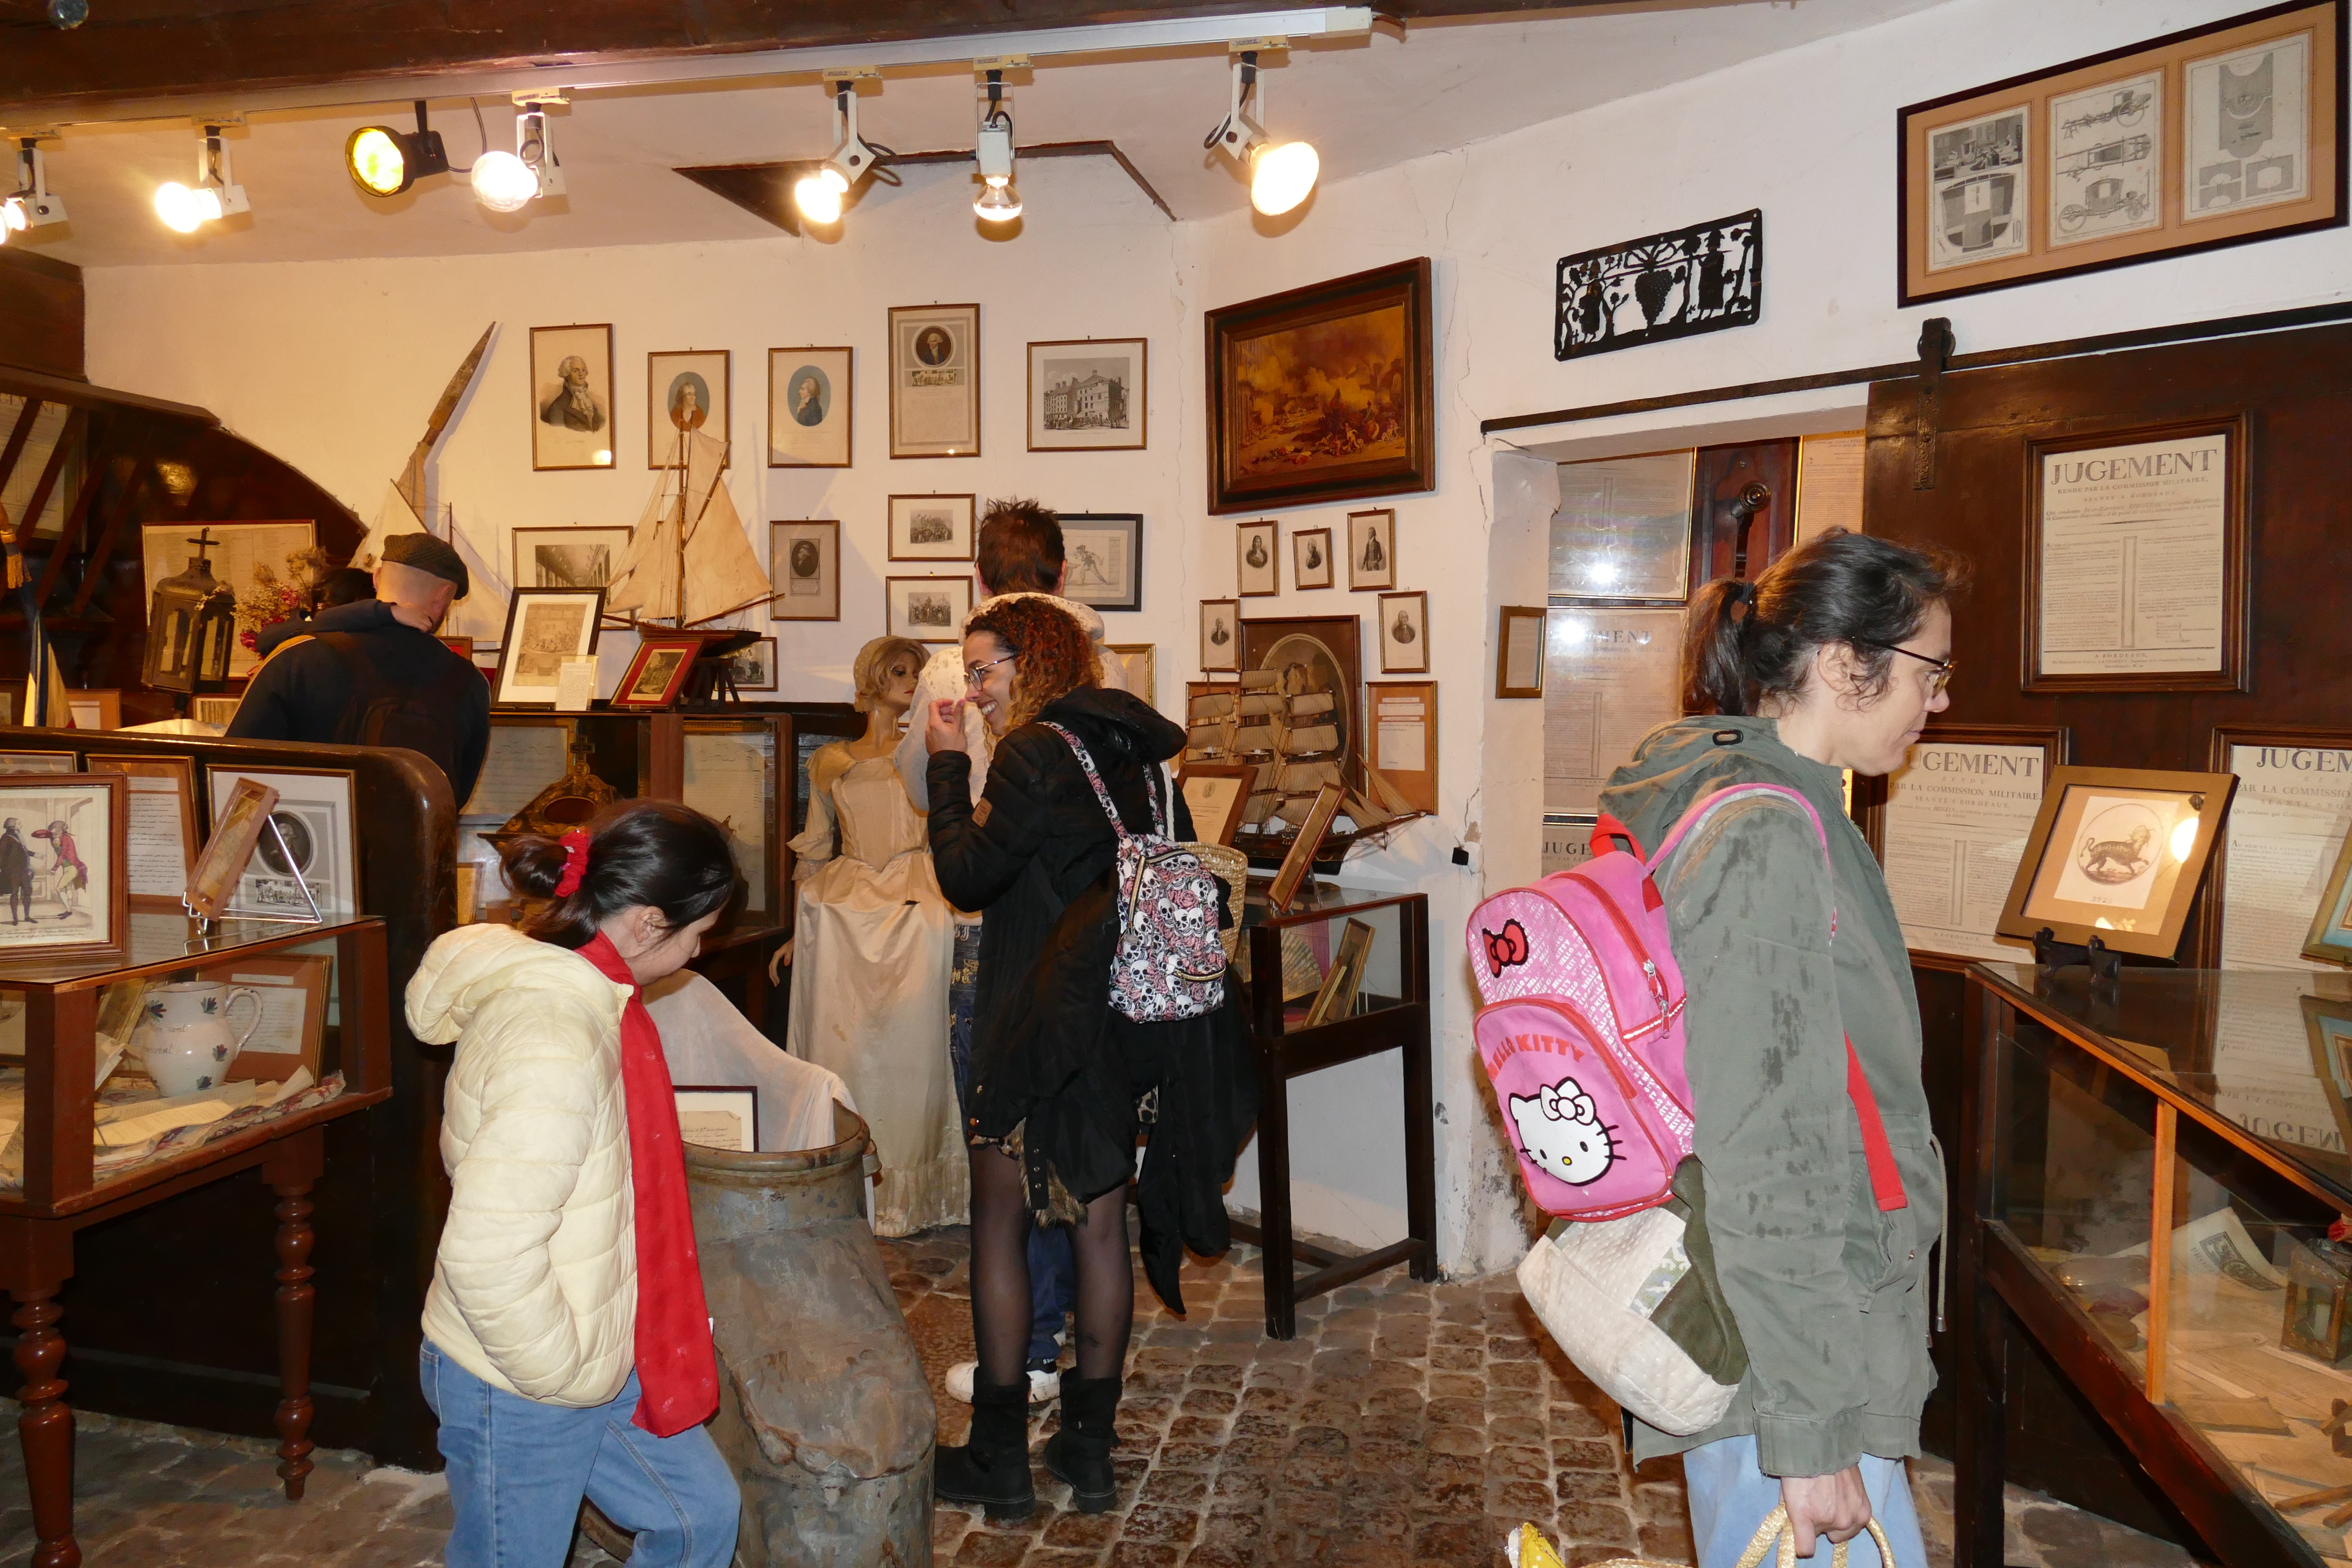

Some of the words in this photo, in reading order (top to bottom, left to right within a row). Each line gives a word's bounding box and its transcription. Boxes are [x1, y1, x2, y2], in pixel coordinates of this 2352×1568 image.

[2051, 449, 2217, 485] JUGEMENT
[2112, 481, 2159, 490] COMMISSION
[2257, 748, 2352, 773] JUGEM
[1890, 782, 1907, 790] PAR
[1927, 785, 1984, 796] COMMISSION
[1989, 789, 2043, 801] MILITAIRE,
[2262, 785, 2277, 793] LA
[1960, 799, 2010, 809] BORDEAUX,
[1542, 842, 1592, 855] JUGE
[1554, 940, 1571, 959] KITTY
[1558, 947, 1575, 966] HELLO
[1551, 970, 1568, 989] HELLO
[1515, 1034, 1585, 1063] KITTY
